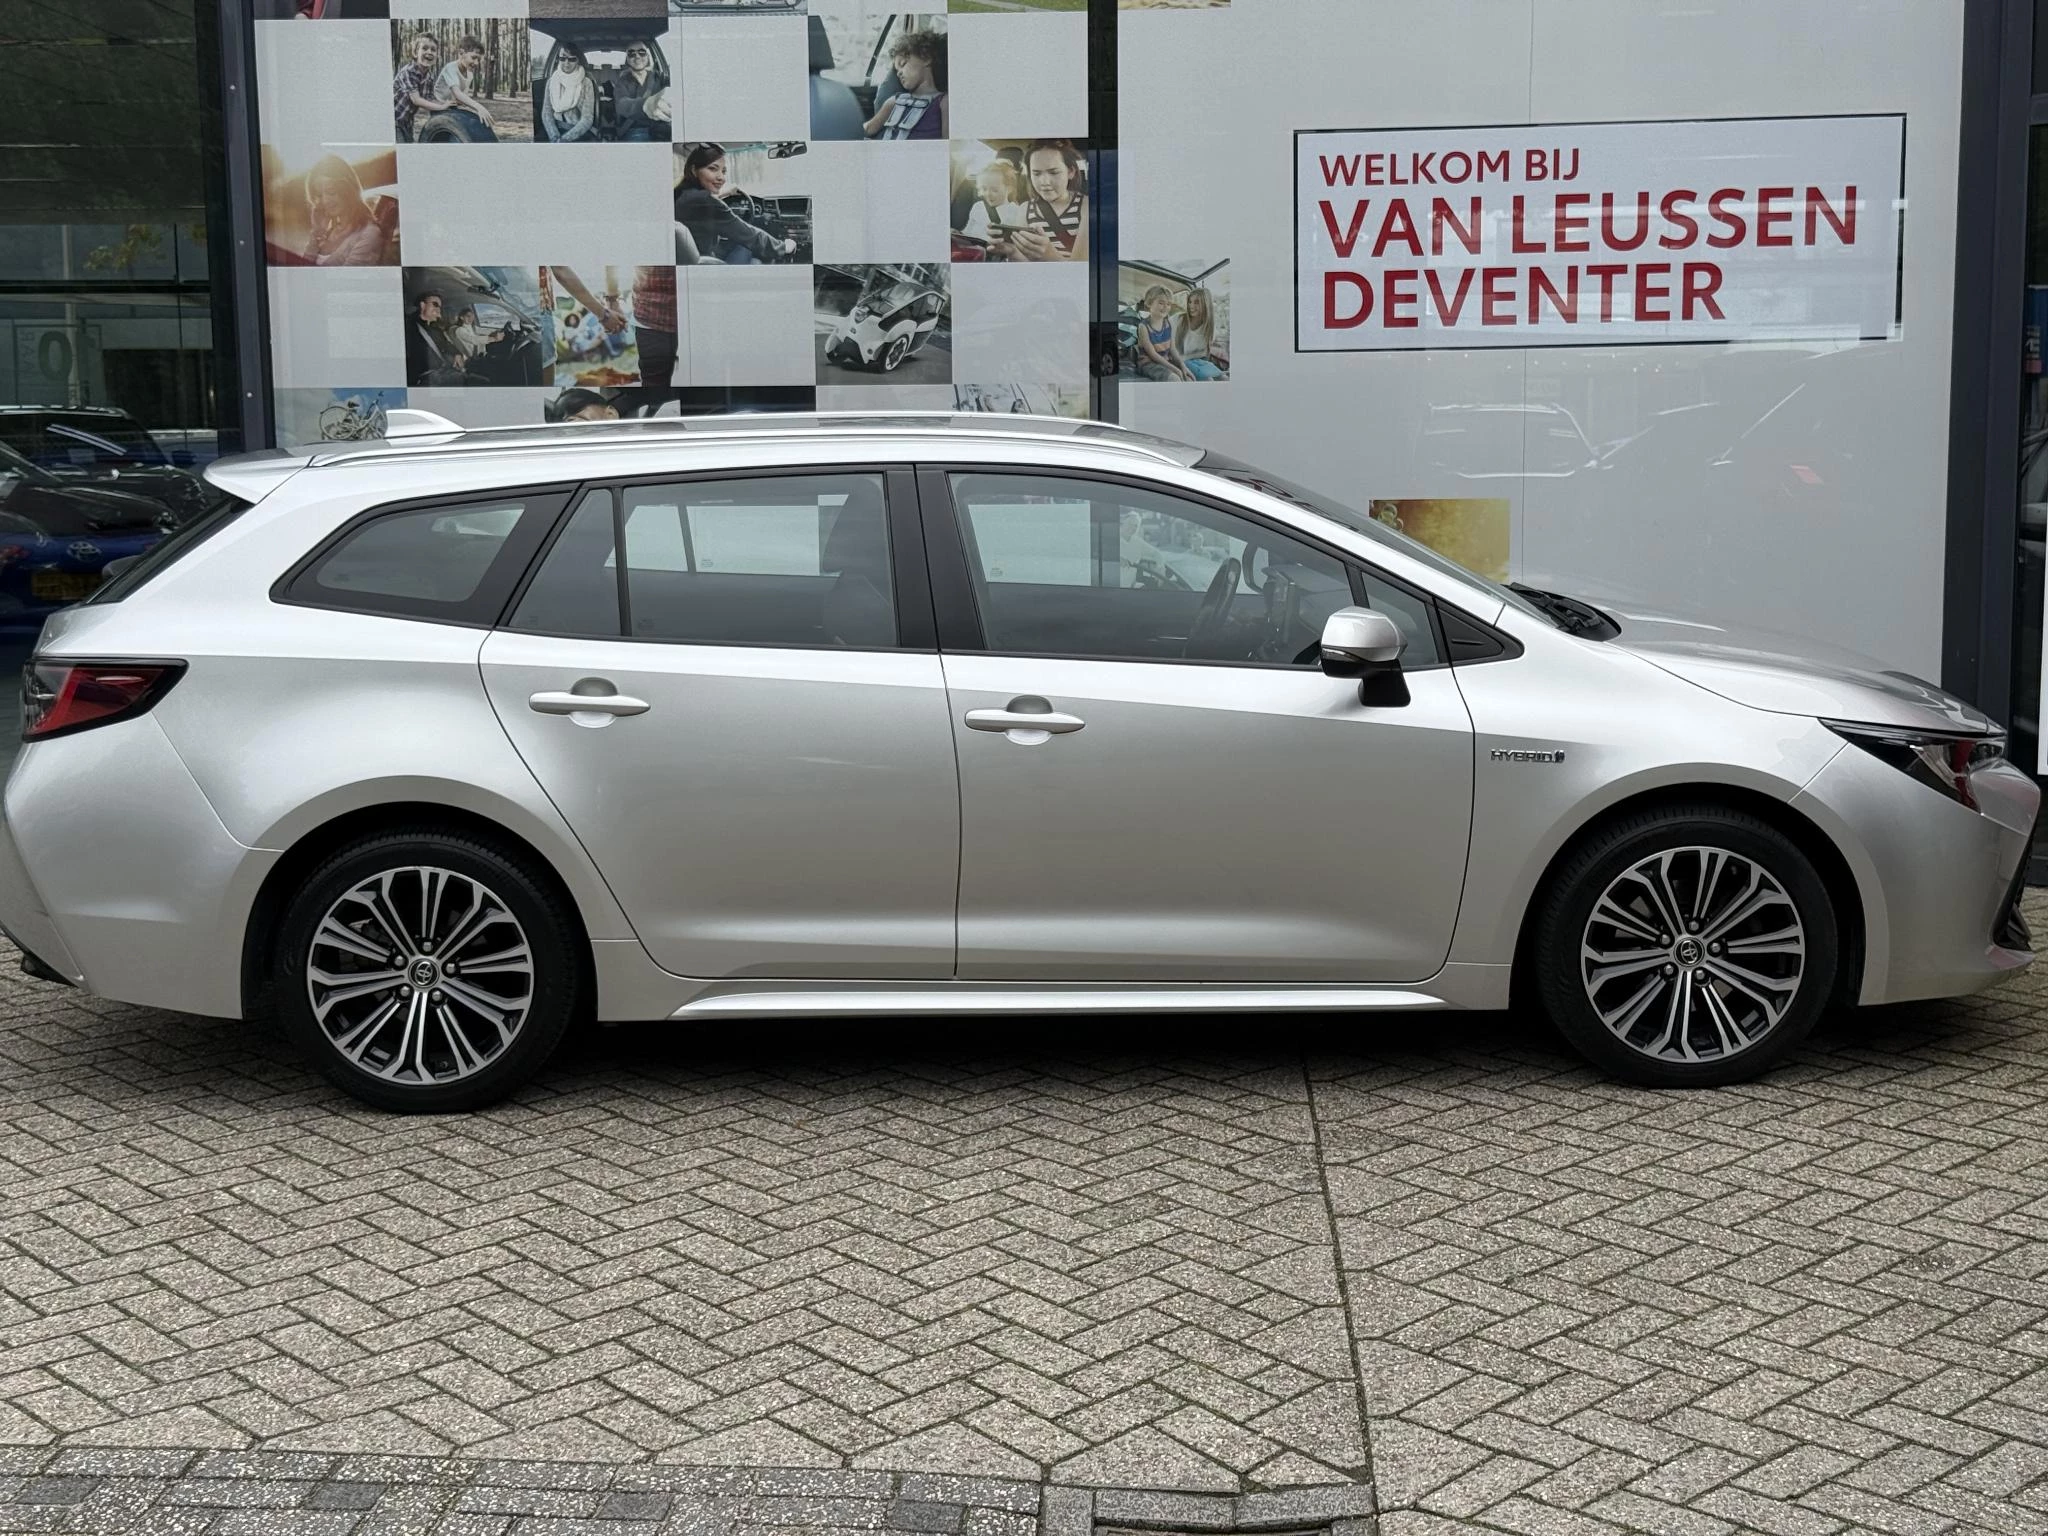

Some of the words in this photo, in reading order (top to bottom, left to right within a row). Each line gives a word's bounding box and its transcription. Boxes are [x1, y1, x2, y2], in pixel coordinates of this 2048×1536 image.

[1320, 150, 1510, 186] WELKOM
[1526, 148, 1580, 181] BIJ
[1319, 196, 1483, 258] VAN
[1511, 185, 1857, 254] LEUSSEN
[1323, 262, 1724, 329] DEVENTER
[1490, 748, 1553, 763] HYBRID
